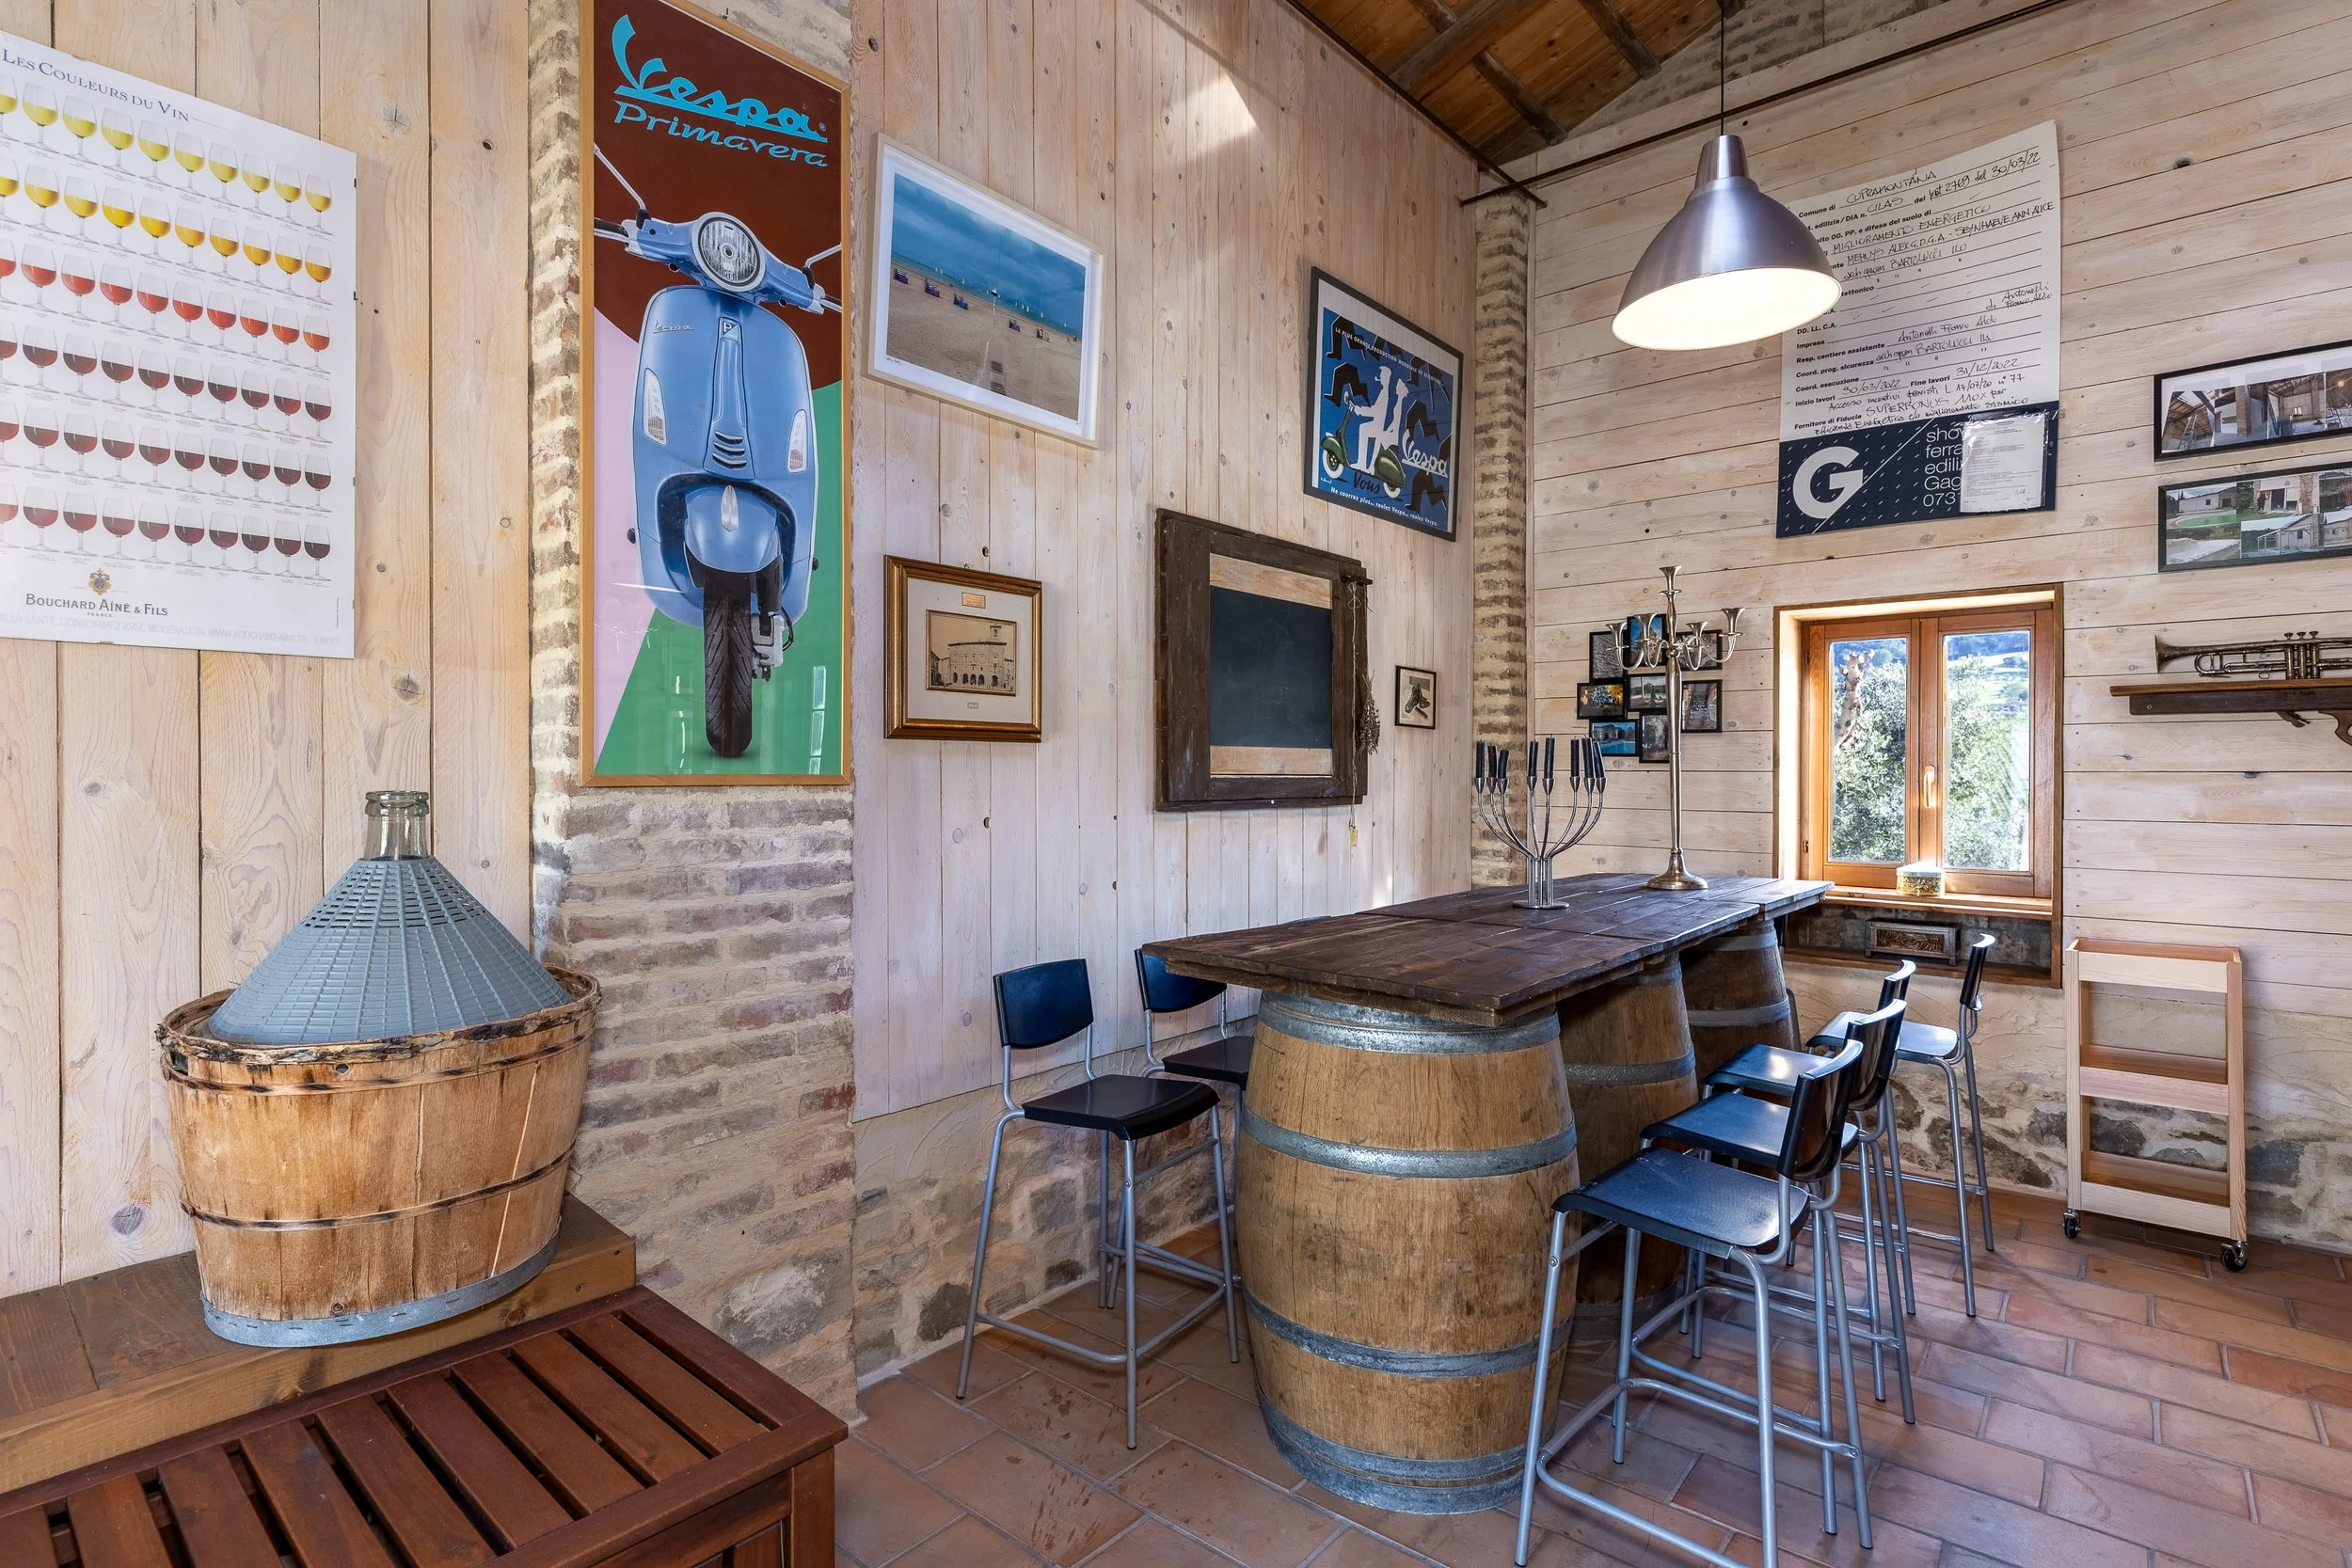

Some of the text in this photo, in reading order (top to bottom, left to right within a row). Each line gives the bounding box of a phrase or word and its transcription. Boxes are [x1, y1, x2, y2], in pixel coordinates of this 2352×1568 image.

[3, 49, 189, 122] LES COULEURS DU VIN
[612, 14, 828, 143] Vespa
[614, 101, 828, 166] Primavera
[1914, 196, 1926, 204] del
[1975, 169, 1987, 182] del
[1799, 207, 1827, 218] Comune
[1865, 222, 1887, 232] difesa
[1888, 217, 1900, 226] del
[1902, 213, 1922, 223] suolo
[1841, 286, 1874, 297] tettonico
[1342, 330, 1354, 340] PLUS
[1796, 340, 1825, 349] Impresa
[1796, 356, 1815, 364] Resp.
[1817, 351, 1846, 360] cantiere
[1847, 342, 1885, 355] assistente
[1796, 370, 1819, 378] Coord.
[1820, 365, 1839, 374] prog.
[1840, 359, 1874, 370] sicurezza
[1795, 377, 1859, 392] Coord. esecuzione
[1795, 398, 1815, 406] Inizio
[1816, 395, 1836, 404] lavori
[1929, 375, 1950, 384] lavori
[1794, 420, 1826, 430] Fornitore
[1836, 414, 1862, 423] Fiducia
[1402, 428, 1448, 478] Vespa
[1925, 443, 1963, 458] ferra
[1353, 472, 1381, 494] Vous
[1792, 446, 1864, 519] G
[1924, 475, 1962, 491] Gag
[1340, 491, 1359, 501] courrez
[1375, 502, 1391, 511] roulez
[1923, 492, 1961, 507] 073
[25, 594, 96, 610] BOUCHARD
[144, 604, 168, 616] FILS
